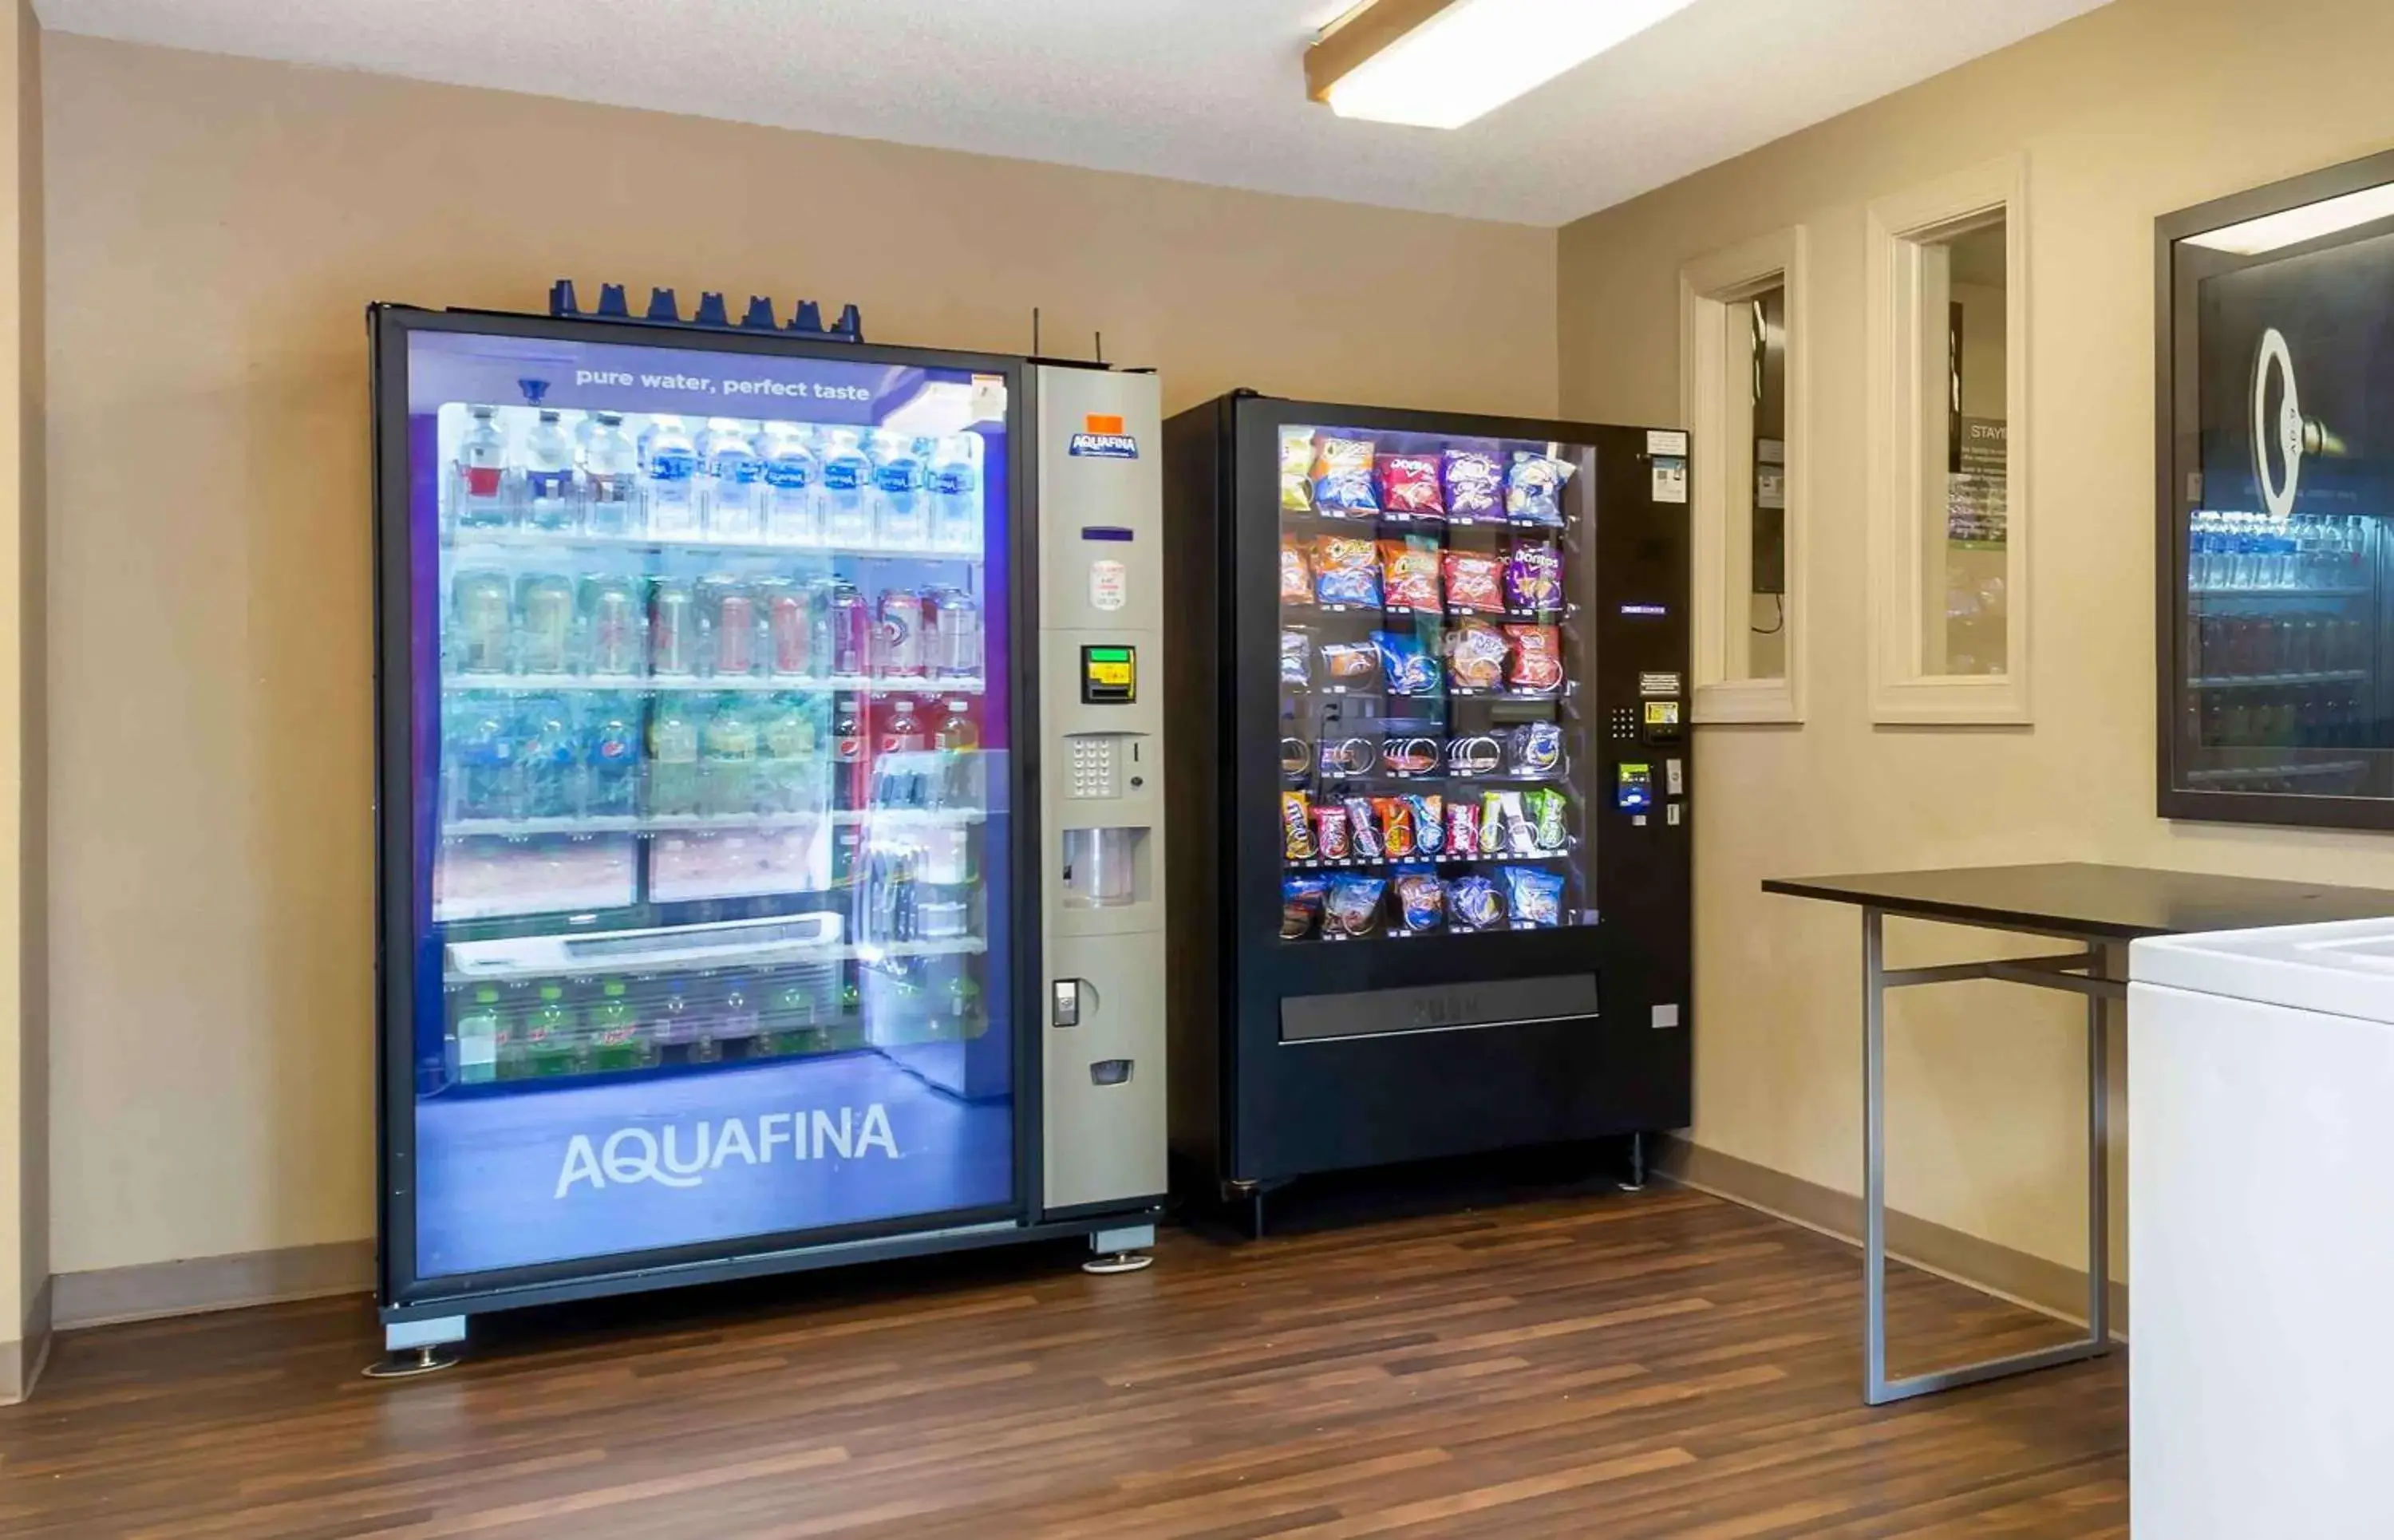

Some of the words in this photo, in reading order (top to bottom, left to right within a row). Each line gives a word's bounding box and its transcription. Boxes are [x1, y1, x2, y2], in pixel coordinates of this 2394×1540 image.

[575, 369, 633, 386] pure
[642, 372, 716, 393] water,
[723, 377, 808, 397] perfect
[813, 383, 870, 401] taste
[1073, 435, 1136, 452] AQUAFINA
[554, 1103, 899, 1199] AQUAFINA
